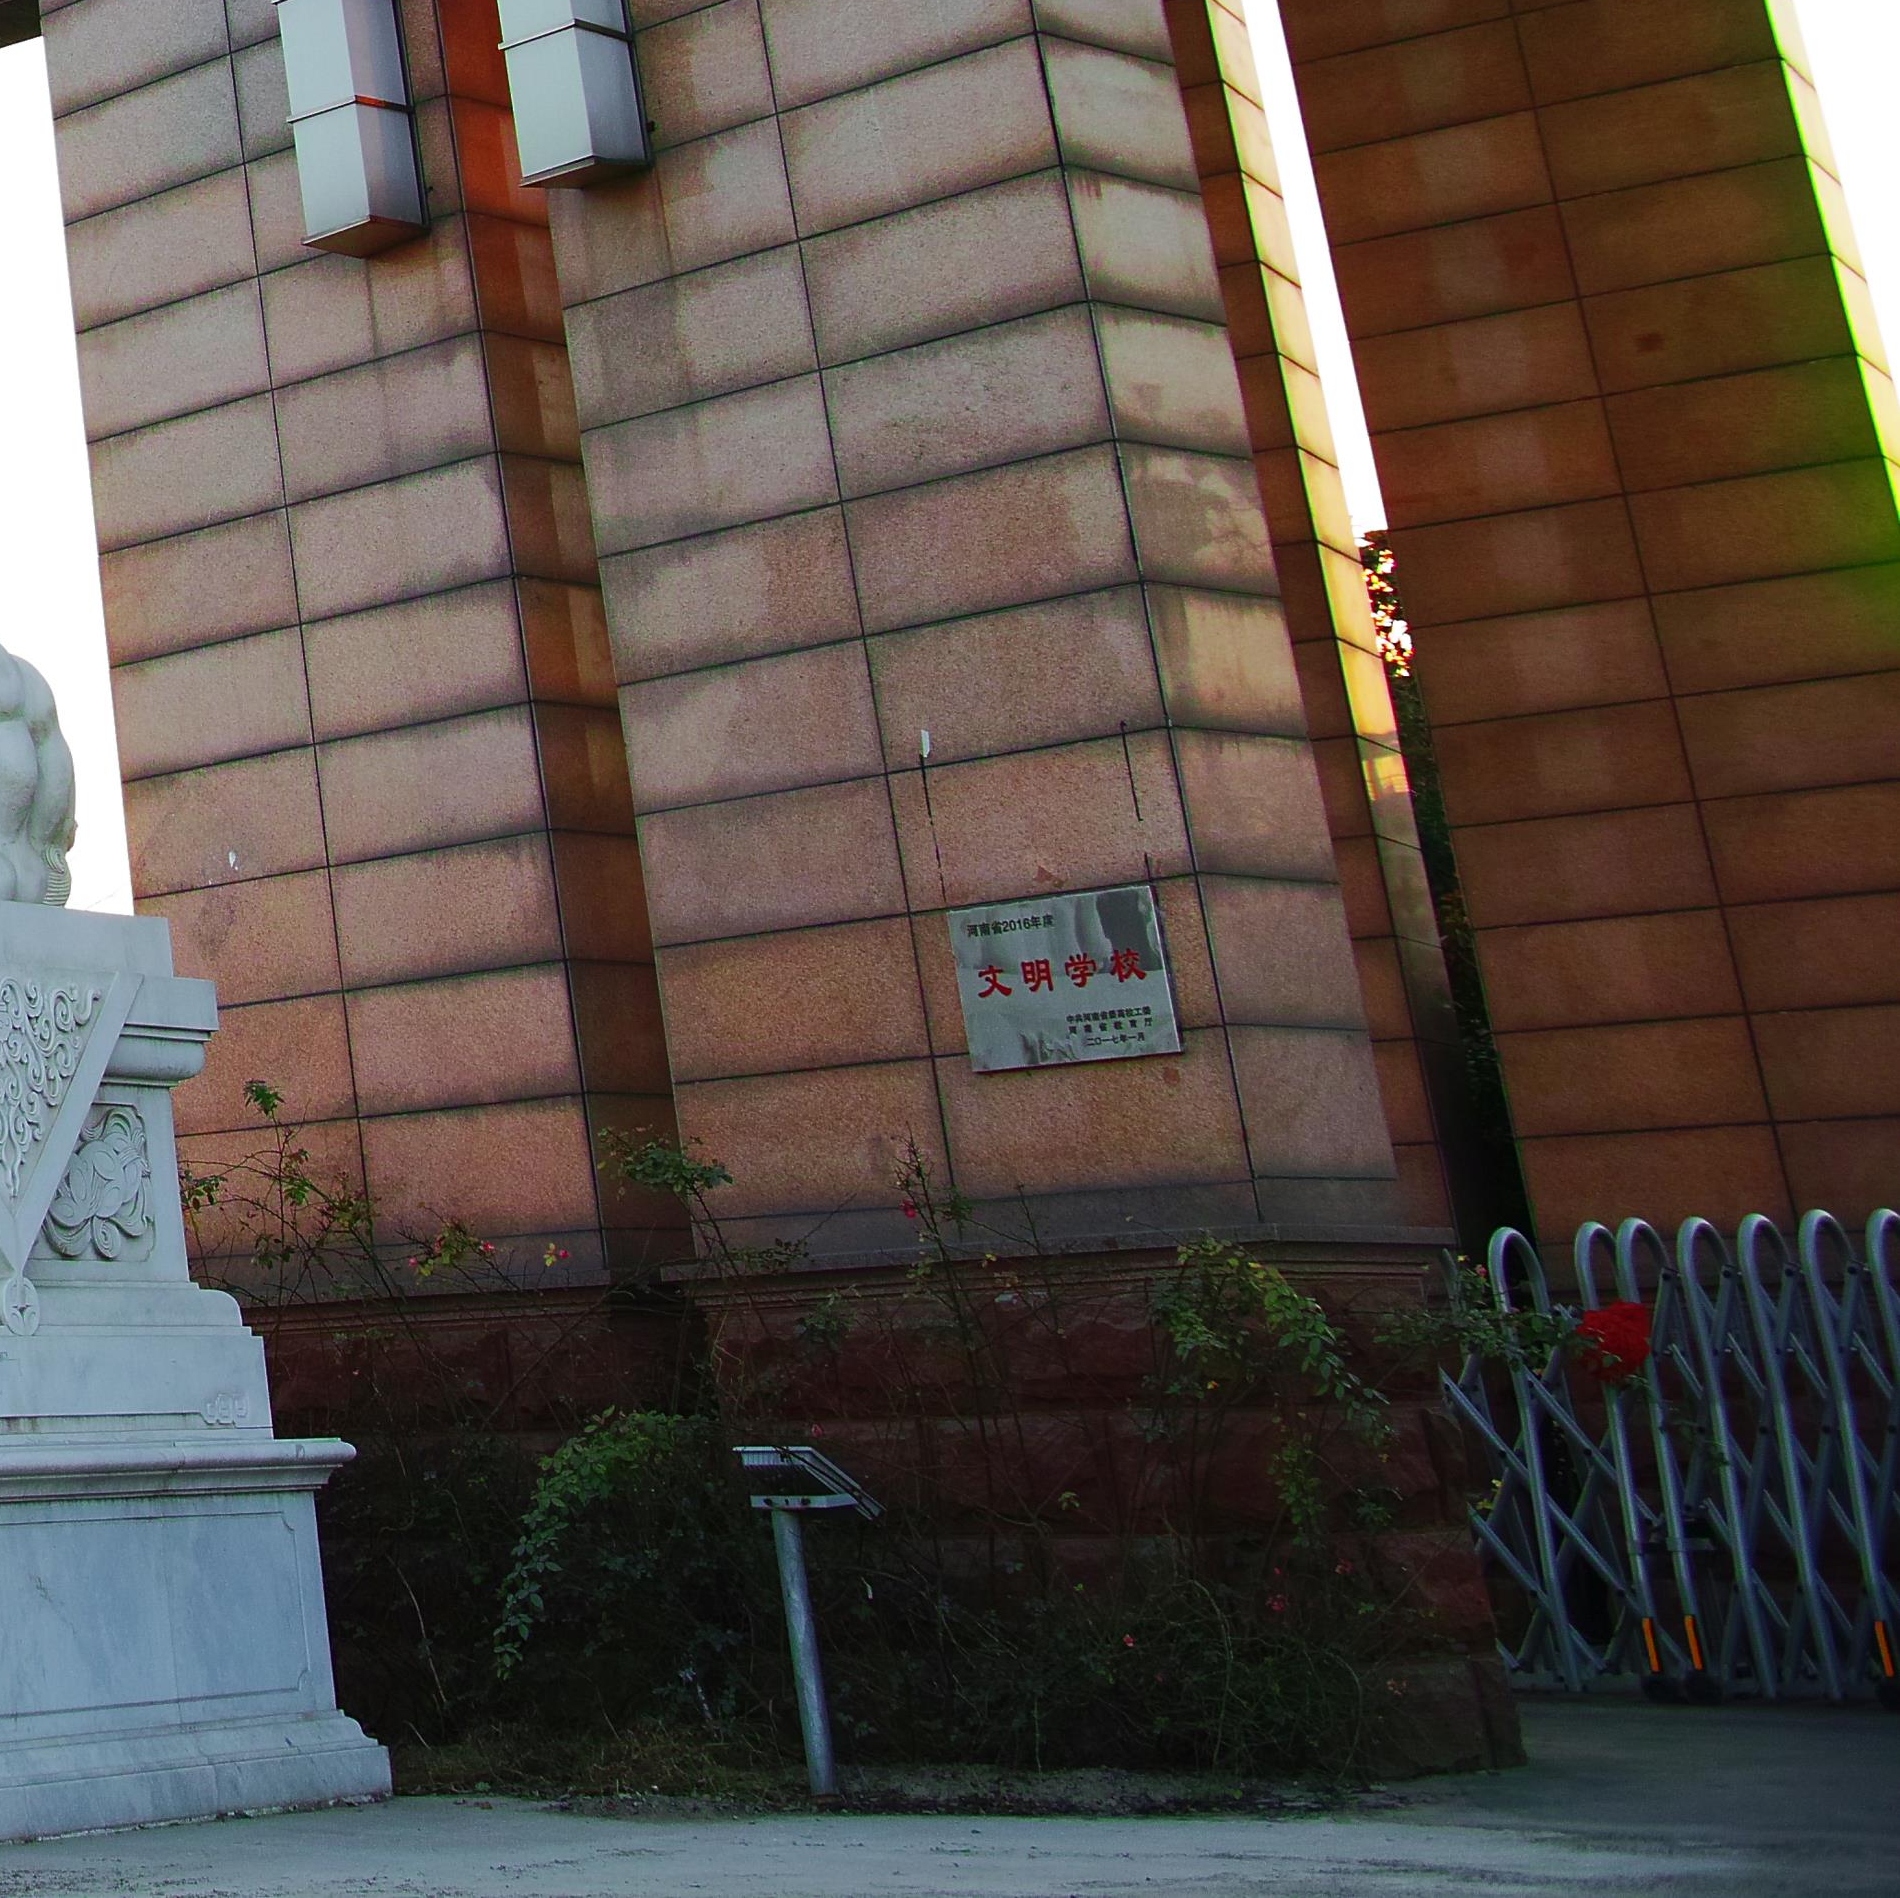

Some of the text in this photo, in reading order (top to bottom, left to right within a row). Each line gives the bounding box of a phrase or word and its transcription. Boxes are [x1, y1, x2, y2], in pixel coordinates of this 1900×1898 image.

[967, 914, 1055, 938] 河南省2016年度
[978, 948, 1148, 999] 文明学校
